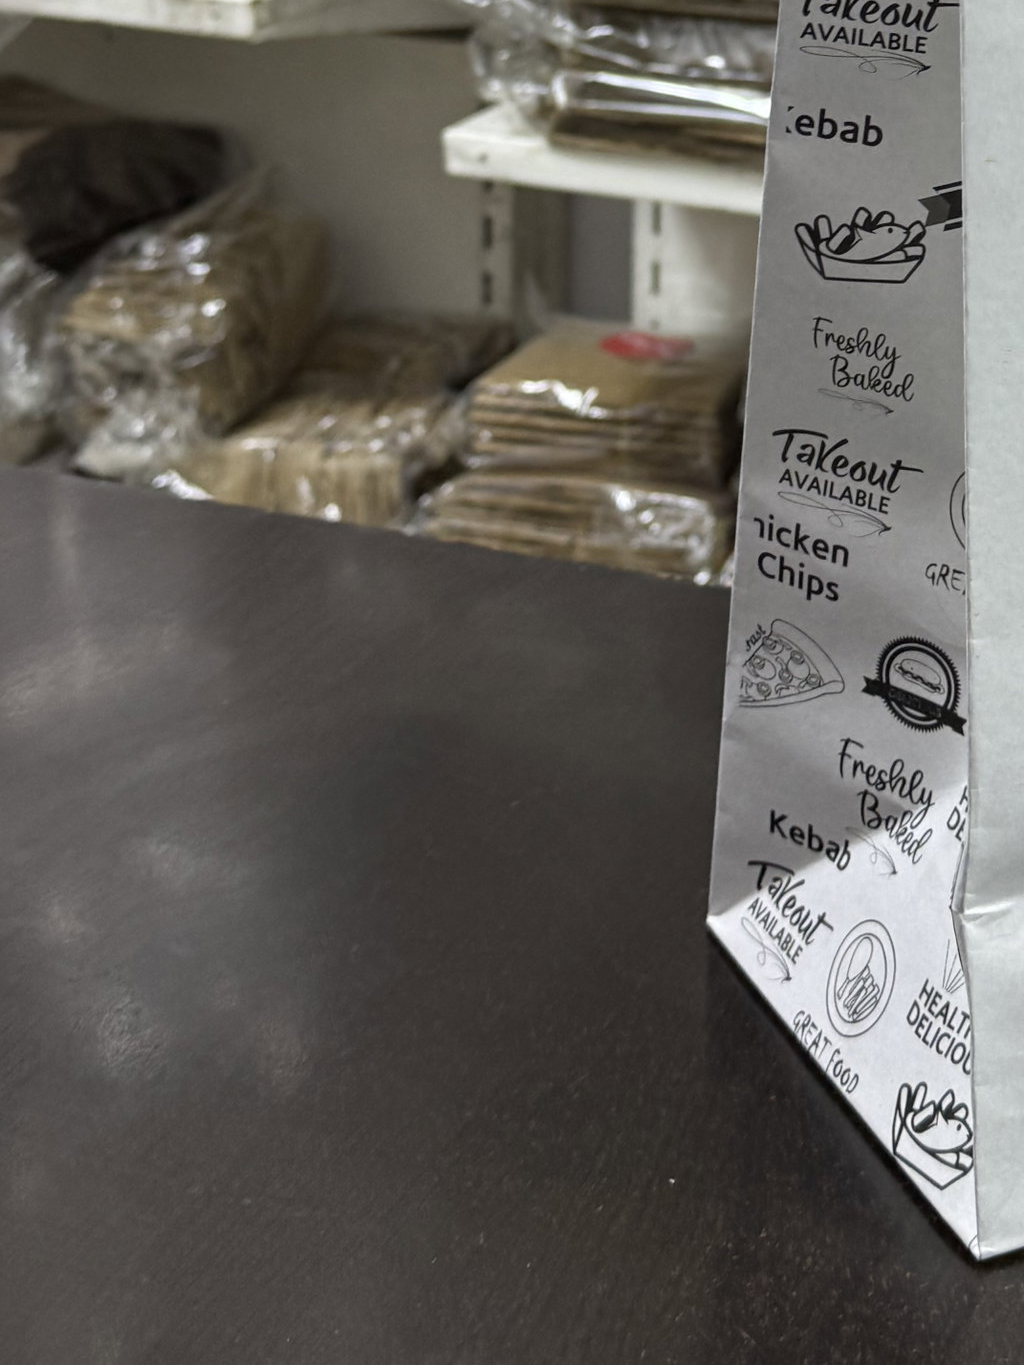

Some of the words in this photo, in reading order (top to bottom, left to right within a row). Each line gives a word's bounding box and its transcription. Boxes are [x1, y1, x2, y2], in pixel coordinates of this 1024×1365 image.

[800, 22, 929, 53] AVAILABLE
[786, 106, 883, 147] ebab
[812, 316, 901, 379] Freshly
[830, 354, 914, 402] Baked
[771, 429, 924, 493] Takeout
[779, 469, 891, 515] AVAILABLE
[757, 551, 839, 602] Chips
[925, 563, 966, 595] GRE
[838, 738, 935, 829] Freshly
[769, 808, 850, 871] Kebab
[857, 789, 933, 864] Baked
[747, 860, 834, 946] Takeout
[748, 897, 803, 965] AVAILABLE
[918, 978, 971, 1039] HEALT
[793, 1010, 832, 1059] GREAT
[826, 1048, 859, 1094] FOOD
